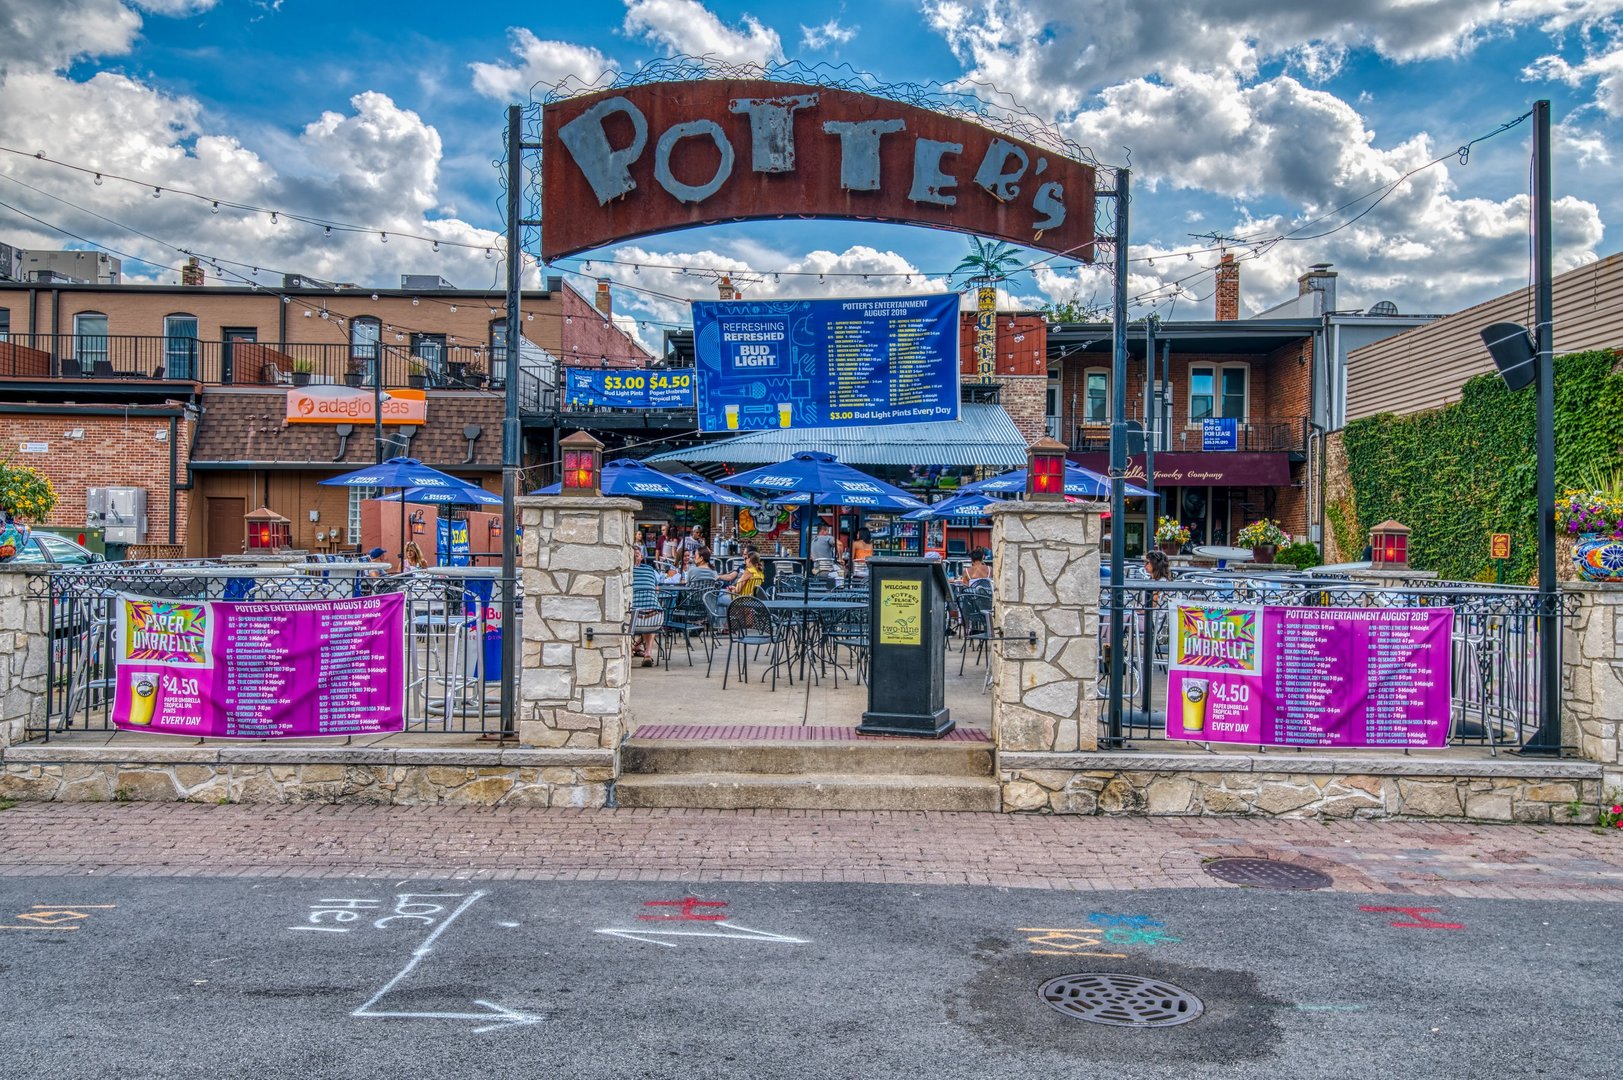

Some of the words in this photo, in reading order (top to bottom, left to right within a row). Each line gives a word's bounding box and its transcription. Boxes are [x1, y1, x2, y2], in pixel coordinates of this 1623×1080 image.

[558, 94, 1066, 229] POTTER'S
[842, 302, 874, 310] POTTER'S
[874, 300, 928, 309] ENTERTAINMENT
[863, 309, 890, 317] AUGUST
[723, 321, 785, 331] REFRESHING
[723, 332, 785, 341] REFRESHED
[740, 345, 770, 356] BUD
[735, 355, 776, 367] LIGHT
[604, 375, 645, 390] $3.00
[649, 375, 690, 390] $4.50
[318, 398, 371, 417] adagio
[380, 402, 409, 414] eas
[830, 411, 853, 420] $3.00
[854, 411, 870, 419] Bud
[871, 411, 891, 420] Light
[892, 409, 912, 417] Pints
[912, 407, 935, 416] Every
[935, 406, 952, 415] Day
[1187, 470, 1223, 480] Company
[234, 604, 270, 613] POTTER'S
[270, 602, 332, 613] ENTERTAINMENT
[333, 601, 362, 610] AUGUST
[363, 599, 381, 609] 2019
[1285, 610, 1320, 619] POTTER'S
[1320, 610, 1380, 621] ENTERTAINMENT
[1380, 611, 1410, 621] AUGUST
[1411, 611, 1429, 621] 2019
[144, 614, 185, 633] PAPER
[882, 624, 919, 633] two-nine
[1196, 619, 1235, 640] PAPER
[132, 631, 199, 653] UMBRELLA
[1184, 637, 1248, 660] UMBRELLA
[163, 674, 199, 696] $4.50
[1212, 681, 1249, 702] $4.50
[161, 716, 185, 725] EVERY
[185, 716, 202, 726] DAY
[1212, 721, 1235, 732] EVERY
[1234, 723, 1250, 733] DAY
